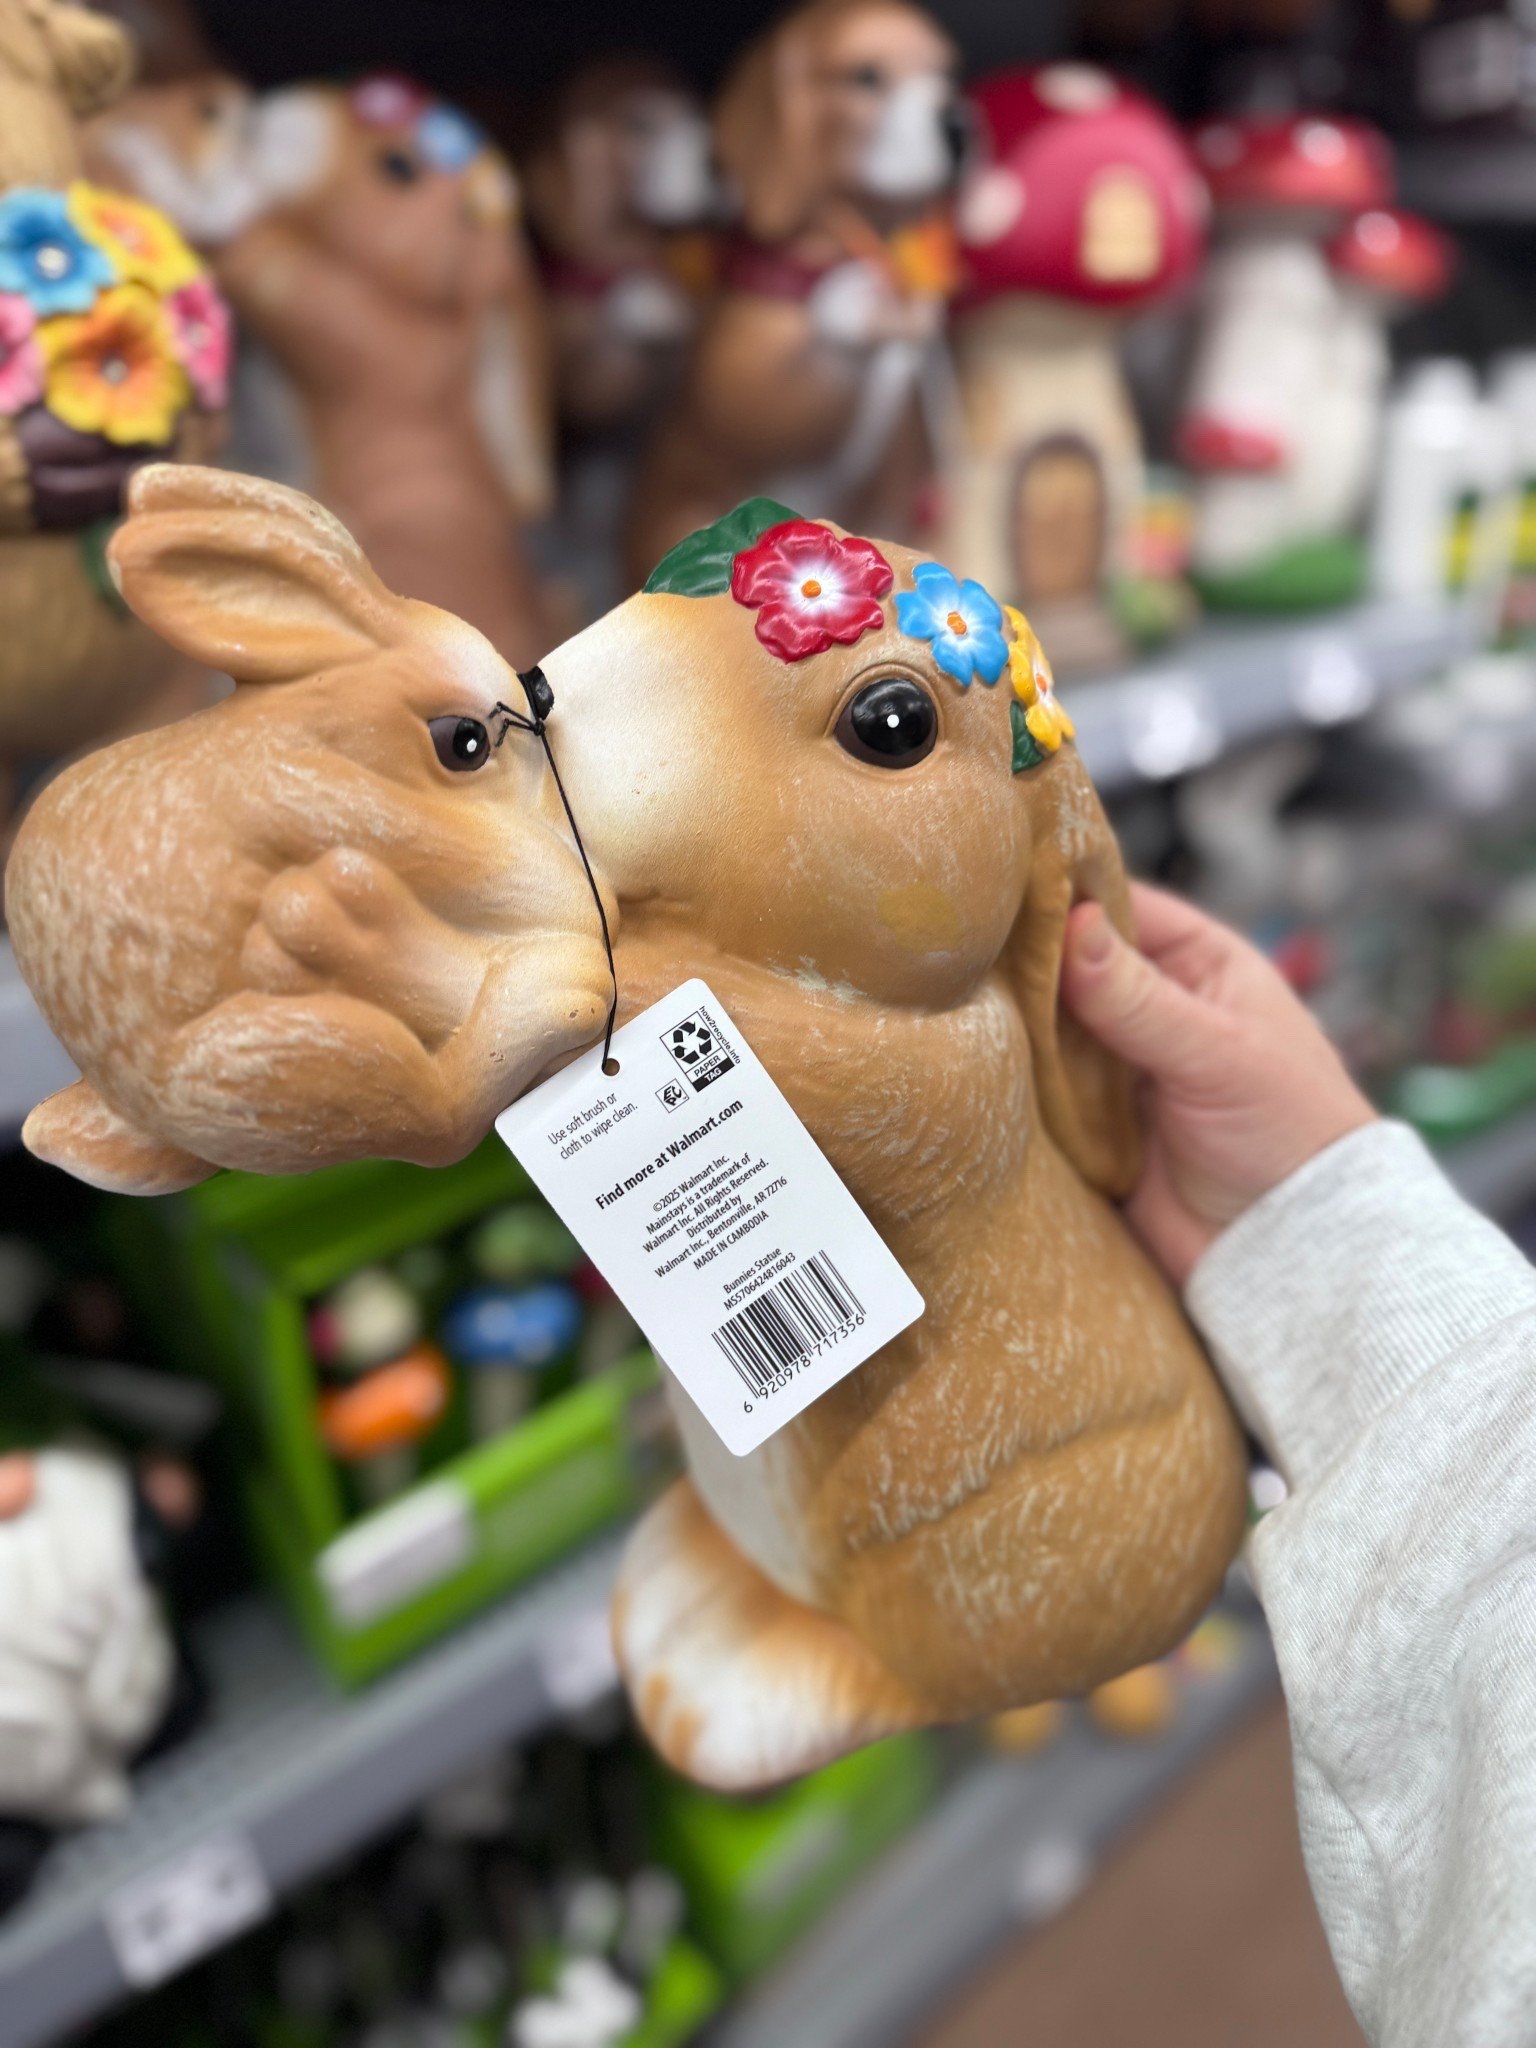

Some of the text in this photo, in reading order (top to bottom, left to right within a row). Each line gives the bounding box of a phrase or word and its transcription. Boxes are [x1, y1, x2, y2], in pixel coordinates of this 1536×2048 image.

[698, 1005, 741, 1065] how2recycle.info
[693, 1054, 721, 1078] PAPER
[704, 1067, 722, 1082] TAG
[547, 1092, 617, 1145] Use soft brush or
[560, 1102, 638, 1160] cloth to wipe clean.
[594, 1100, 744, 1211] Find more at Walmart.com
[677, 1164, 716, 1194] Walmart
[712, 1155, 730, 1169] Inc.
[642, 1157, 769, 1253] Walmart Inc. All Rights Reserved.
[645, 1151, 751, 1235] Mainstays is a trademark of
[685, 1194, 742, 1239] Distributed by
[654, 1175, 788, 1278] Walmart Inc., Bentonville, AR 72716
[693, 1210, 770, 1271] MADE IN CAMBODIA
[722, 1248, 782, 1295] Bunnies Statue
[723, 1251, 796, 1311] MS5706424816043
[743, 1313, 865, 1414] 6 920978 717356
